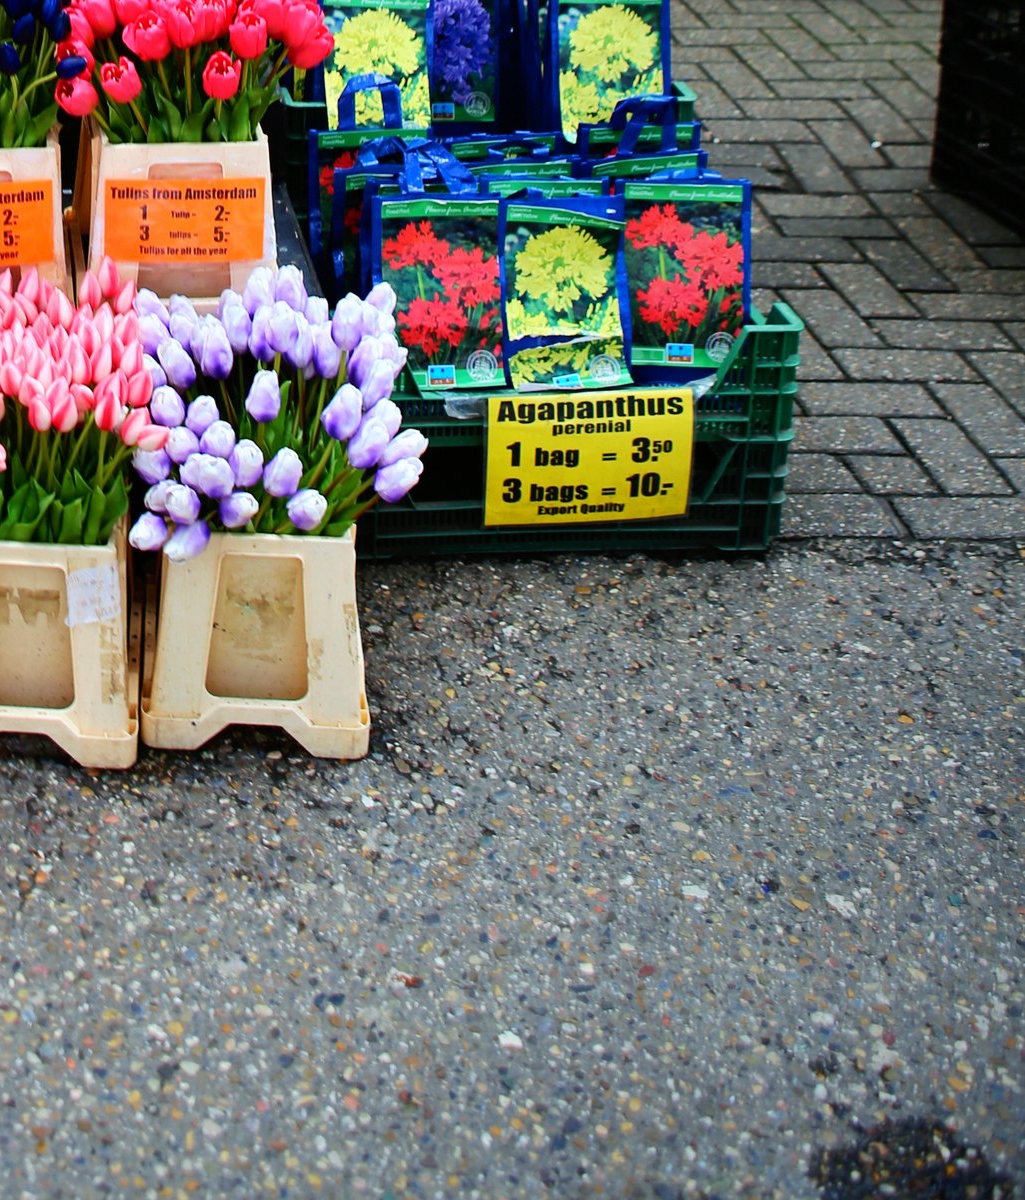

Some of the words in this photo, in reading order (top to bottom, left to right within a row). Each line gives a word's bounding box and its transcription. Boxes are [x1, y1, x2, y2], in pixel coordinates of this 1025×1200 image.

[110, 186, 149, 200] Tulips
[152, 187, 182, 200] from
[185, 187, 257, 200] Amsterdam
[139, 205, 147, 220] 1
[170, 210, 190, 219] Tulip
[139, 225, 150, 241] 3
[0, 250, 19, 261] year
[139, 245, 165, 255] Tulips
[167, 246, 178, 255] for
[181, 246, 192, 255] all
[193, 246, 207, 255] the
[209, 248, 227, 256] year
[497, 395, 684, 424] Agapanthus
[552, 420, 631, 436] perenial
[506, 442, 521, 467] 1
[534, 447, 579, 468] bag
[632, 437, 673, 463] 3.50
[502, 478, 522, 503] 3
[530, 483, 588, 502] bags
[537, 505, 577, 516] Export
[580, 502, 625, 514] Quality
